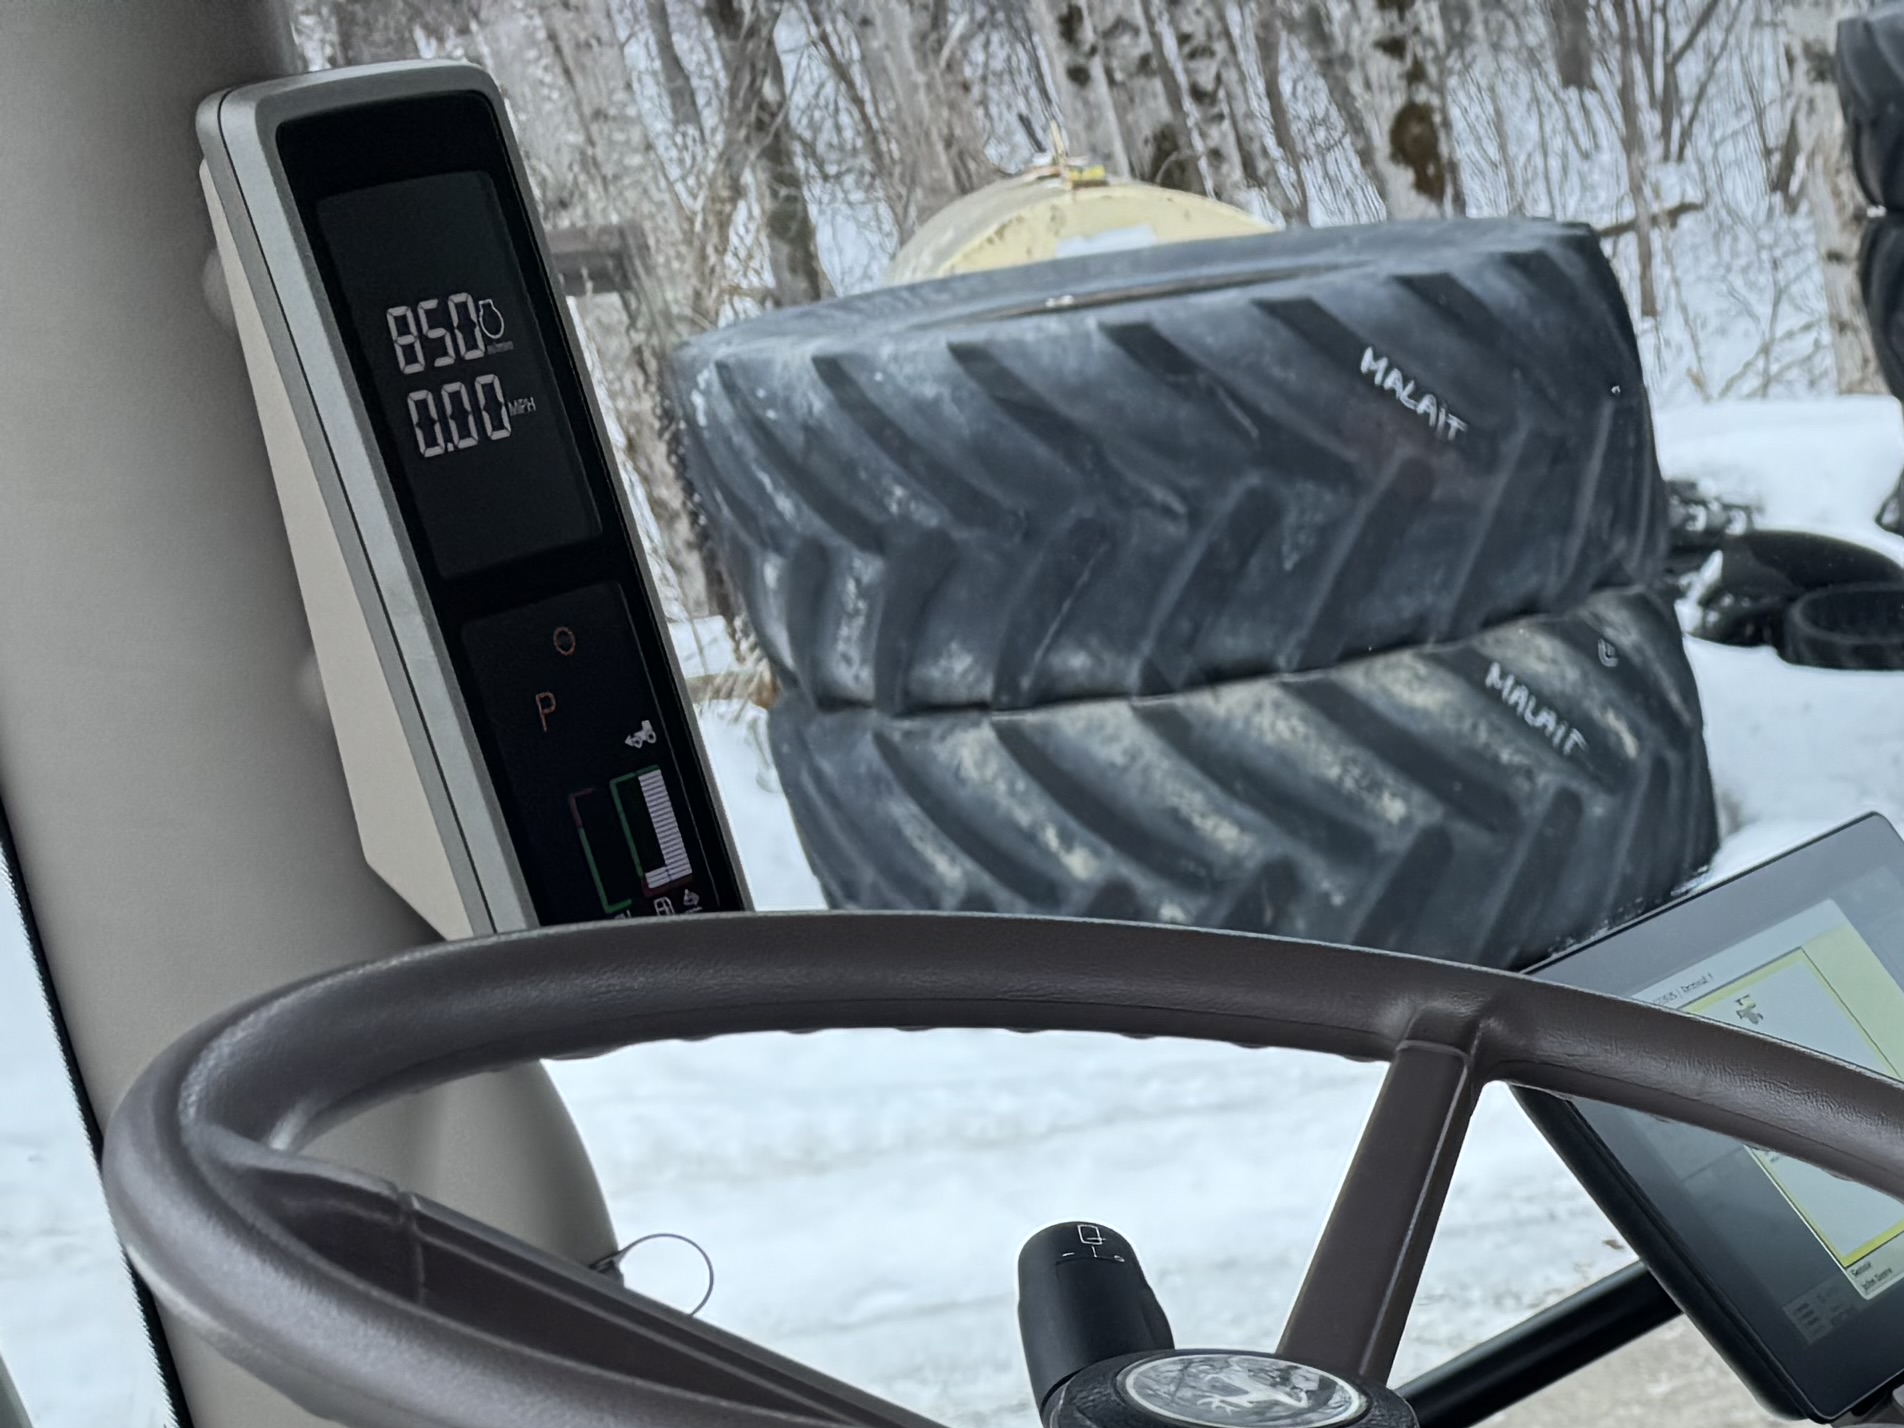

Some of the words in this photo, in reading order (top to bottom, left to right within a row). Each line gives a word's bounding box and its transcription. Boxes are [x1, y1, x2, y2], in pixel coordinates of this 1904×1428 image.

[386, 292, 485, 374] 850
[407, 374, 511, 457] 0.00
[509, 397, 536, 416] MPH
[1360, 346, 1467, 440] MALAIT
[536, 691, 556, 731] P
